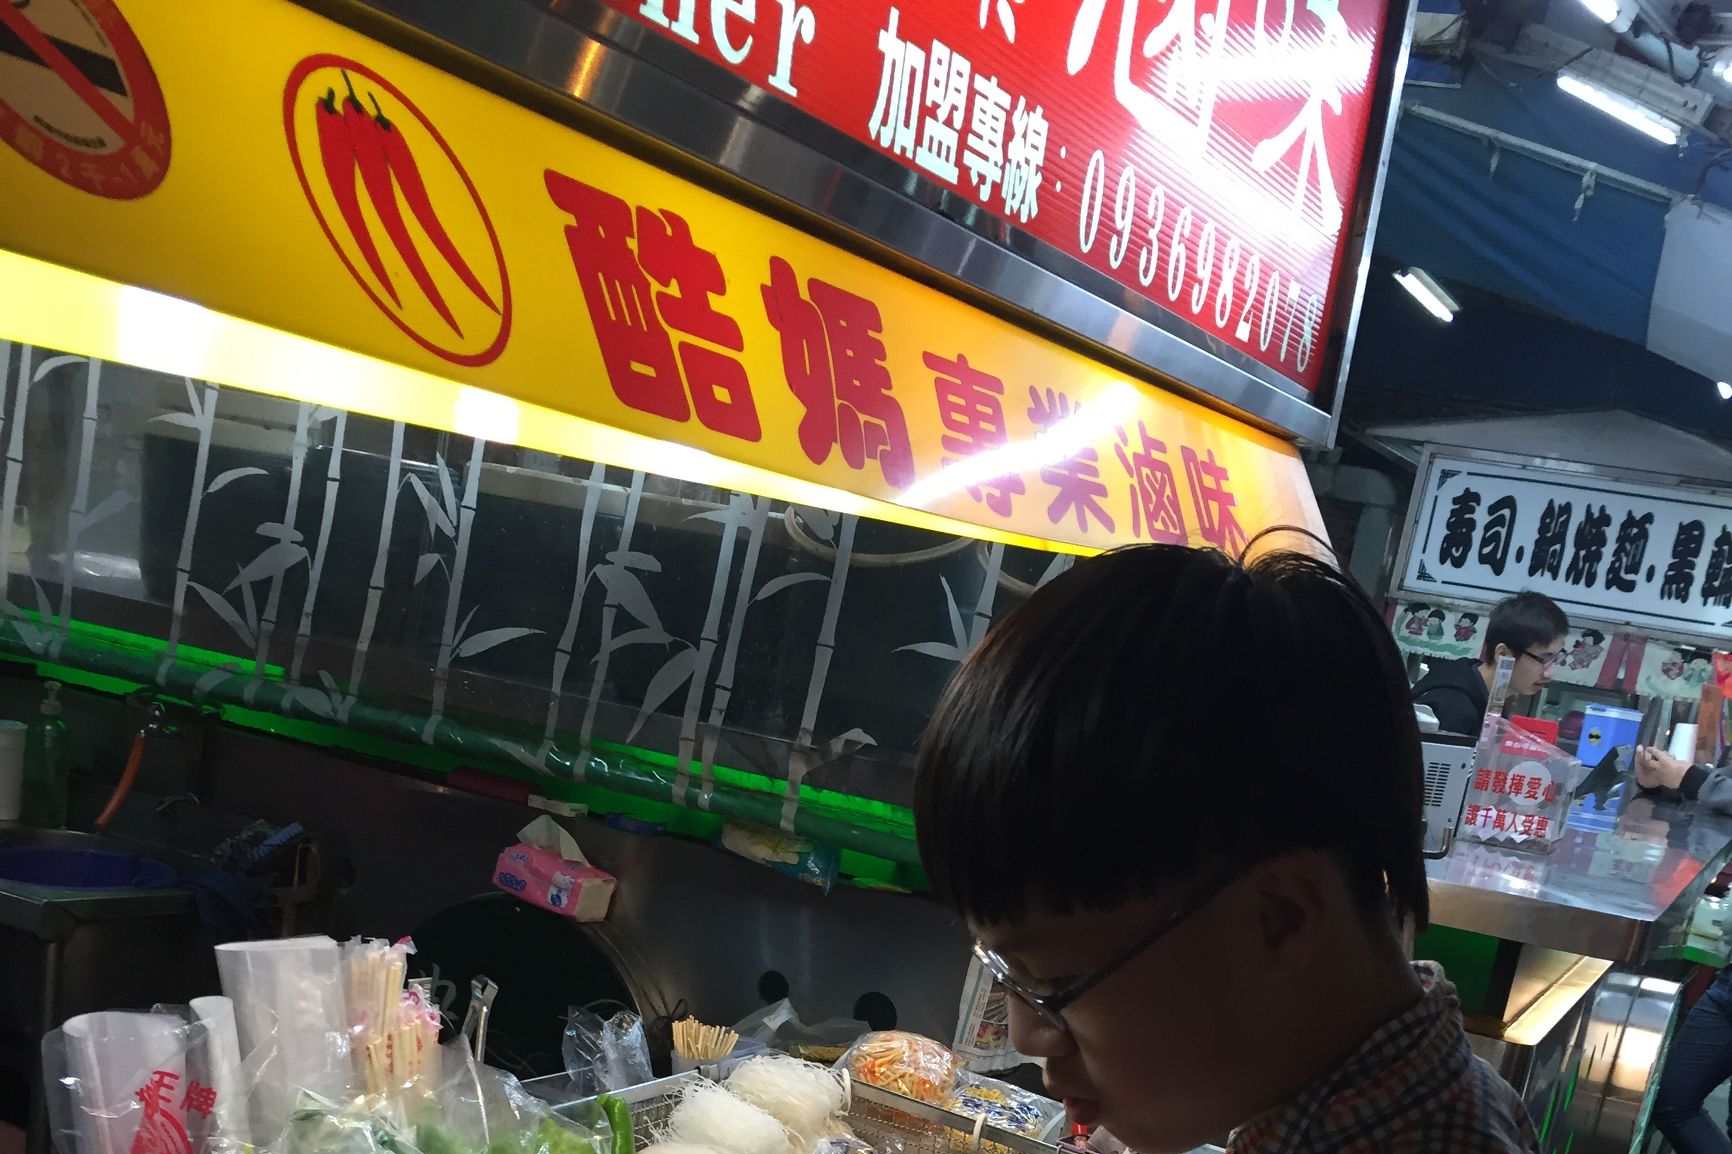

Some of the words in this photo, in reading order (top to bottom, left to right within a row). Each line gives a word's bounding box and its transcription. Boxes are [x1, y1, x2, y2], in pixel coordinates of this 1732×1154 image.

[1473, 767, 1559, 804] 請發揮愛心
